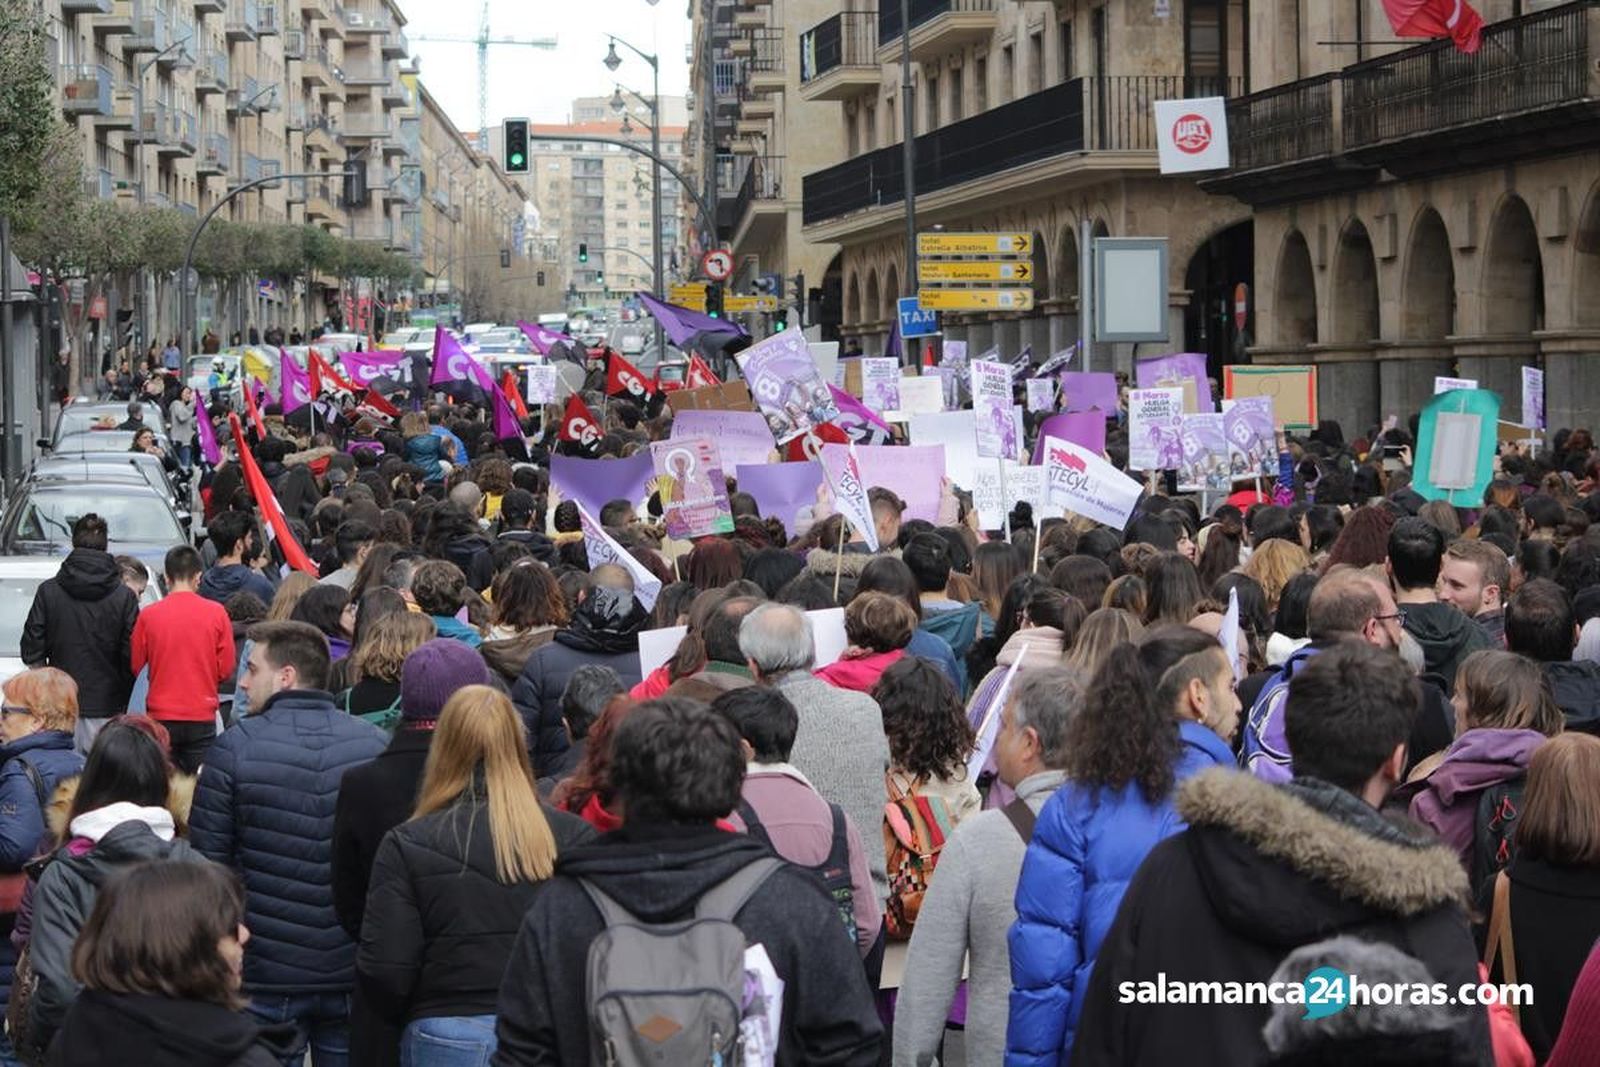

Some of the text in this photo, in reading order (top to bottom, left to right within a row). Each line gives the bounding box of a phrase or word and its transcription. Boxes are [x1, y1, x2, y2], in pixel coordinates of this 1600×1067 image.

[1177, 120, 1207, 138] UGT
[902, 309, 936, 324] TAXI
[358, 356, 414, 383] CGT
[983, 363, 1006, 375] Marzo
[1142, 391, 1171, 400] Marzo
